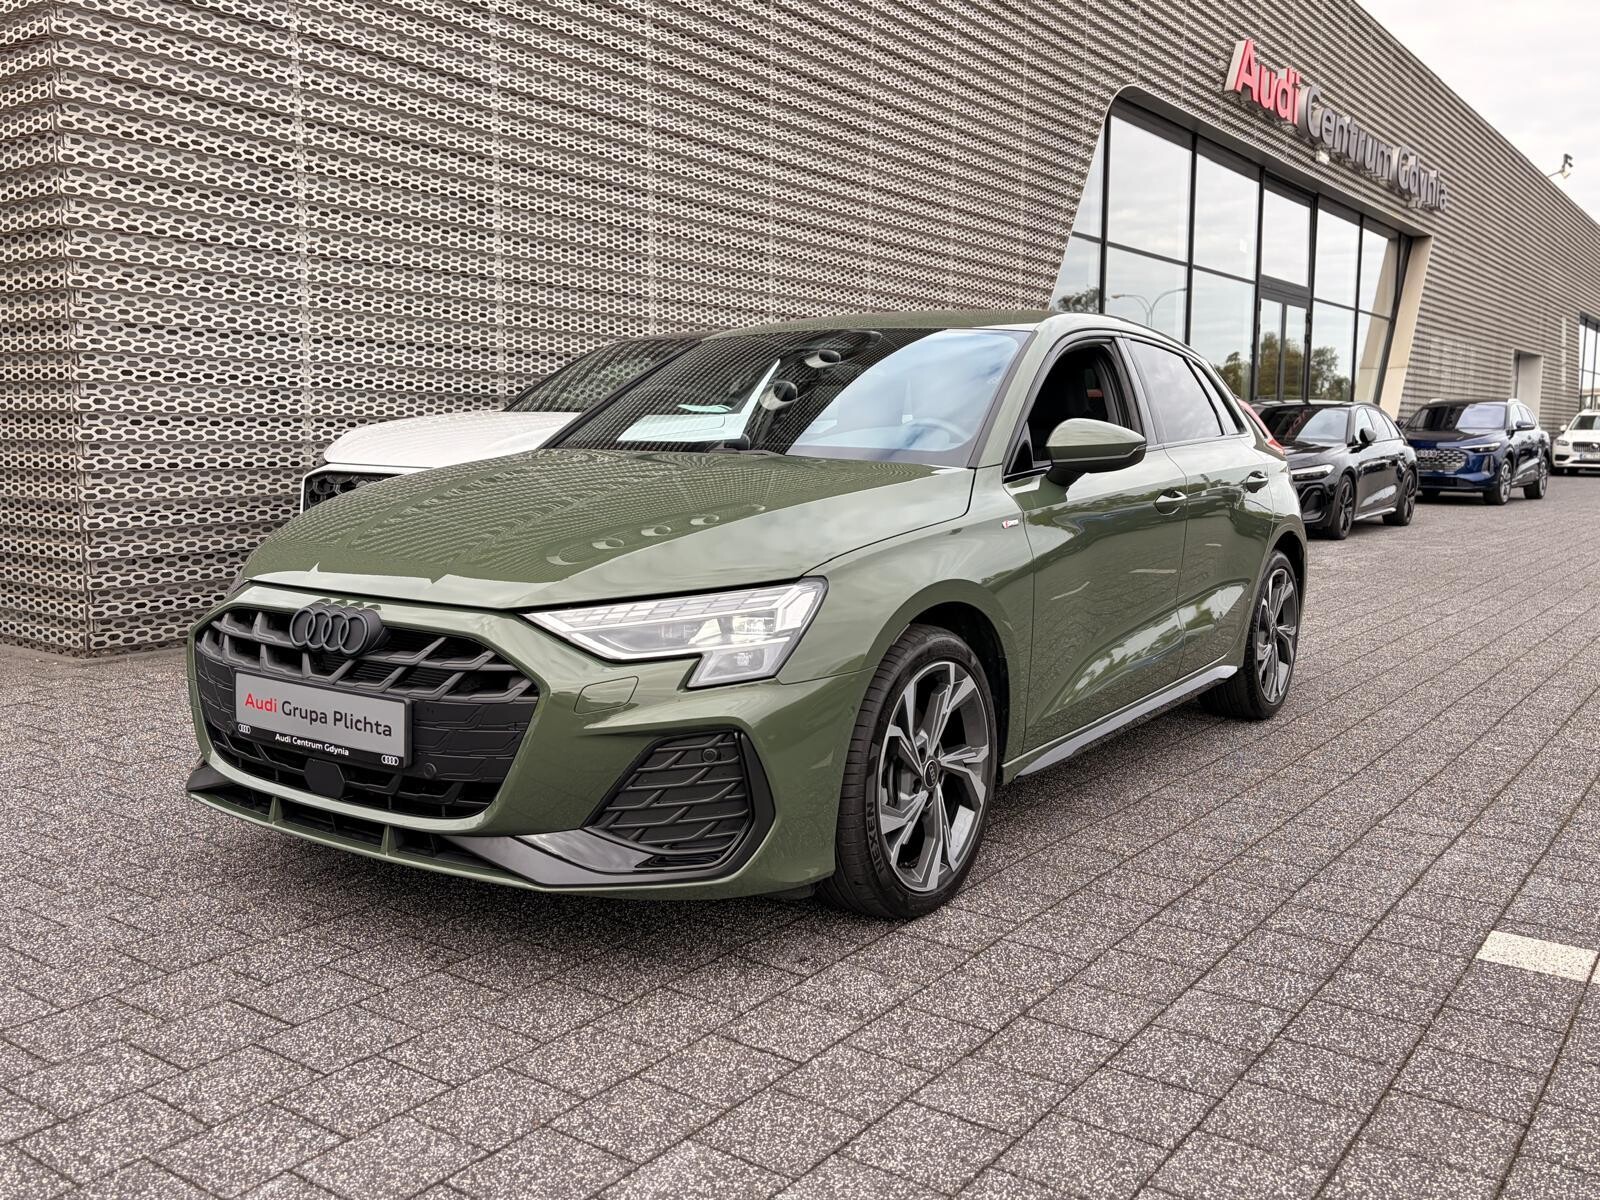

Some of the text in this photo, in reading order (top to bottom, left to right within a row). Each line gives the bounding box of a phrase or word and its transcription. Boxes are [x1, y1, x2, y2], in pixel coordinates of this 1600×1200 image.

[1225, 39, 1447, 212] Audi Centrum Gdynia
[244, 692, 393, 737] Audi Grupa Plichta
[275, 733, 349, 756] Audi Centrum Gdynia
[866, 801, 886, 875] NEXEN
